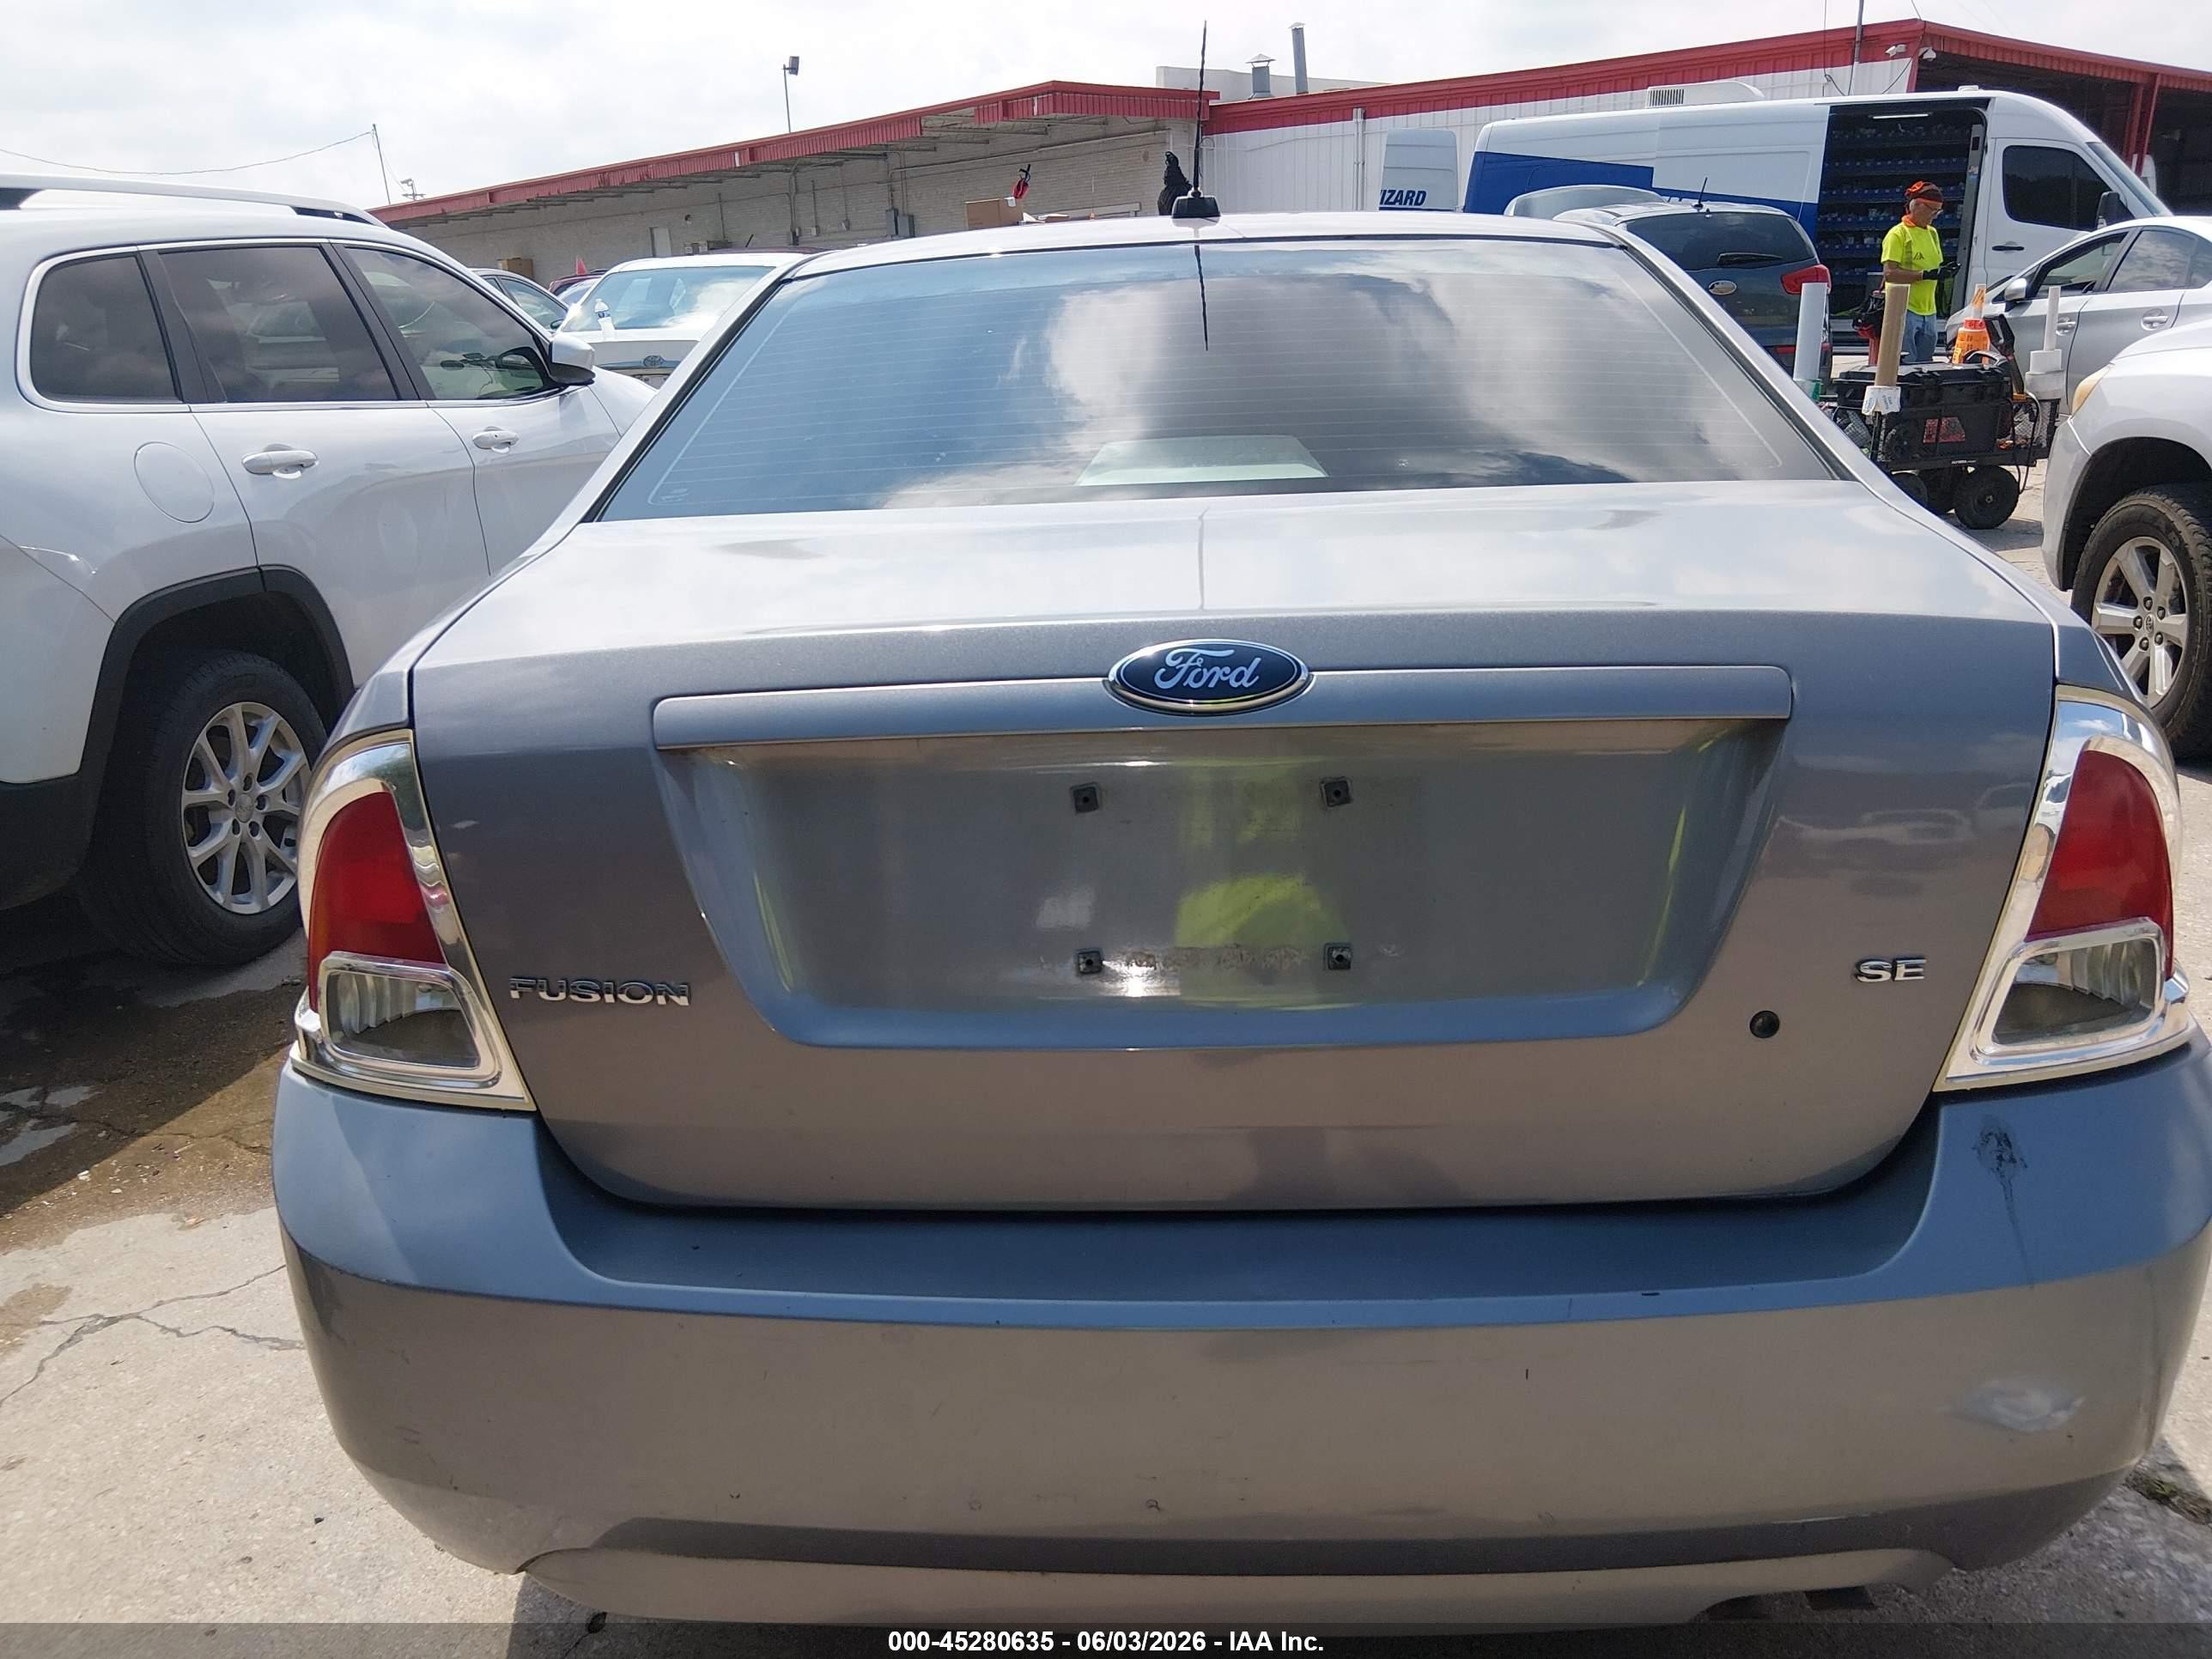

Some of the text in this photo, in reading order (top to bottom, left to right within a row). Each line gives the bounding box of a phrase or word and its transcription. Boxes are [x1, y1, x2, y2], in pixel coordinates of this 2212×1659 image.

[1379, 189, 1427, 206] IZARD
[1154, 647, 1261, 689] Ford
[1856, 958, 1926, 982] SE
[508, 977, 690, 1006] FUSION
